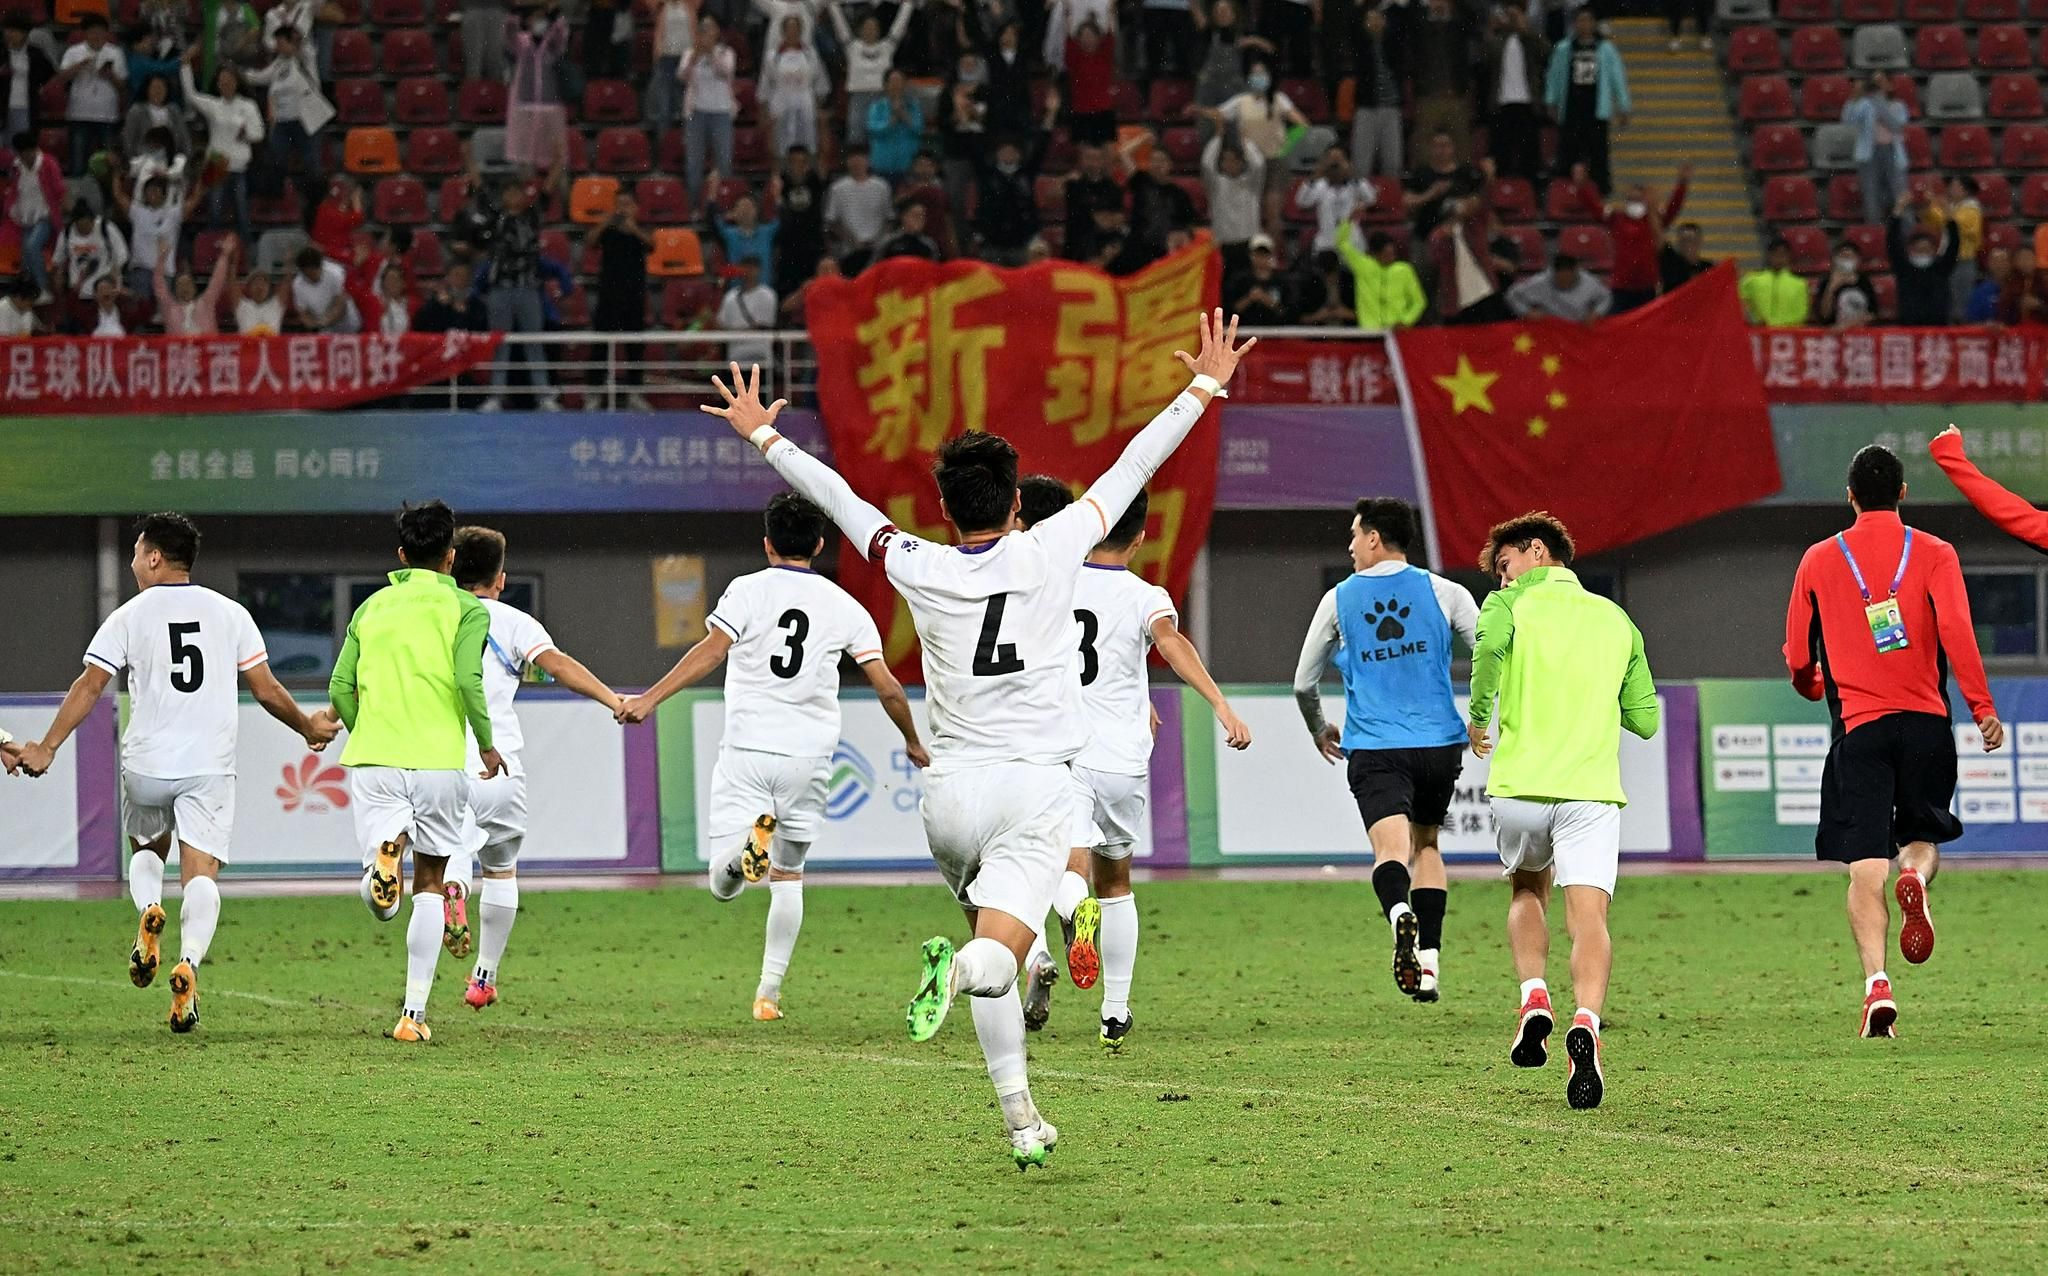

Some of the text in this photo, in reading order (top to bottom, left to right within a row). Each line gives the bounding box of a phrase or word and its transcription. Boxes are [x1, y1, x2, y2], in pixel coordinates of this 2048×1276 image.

[5, 333, 404, 401] 足球队向陕西人民问好
[857, 241, 1214, 462] 新疆
[1270, 354, 1396, 403] 一鼓作
[168, 621, 204, 693] 5
[769, 608, 810, 679] 3
[972, 591, 1025, 677] 4
[1360, 640, 1428, 663] KELME
